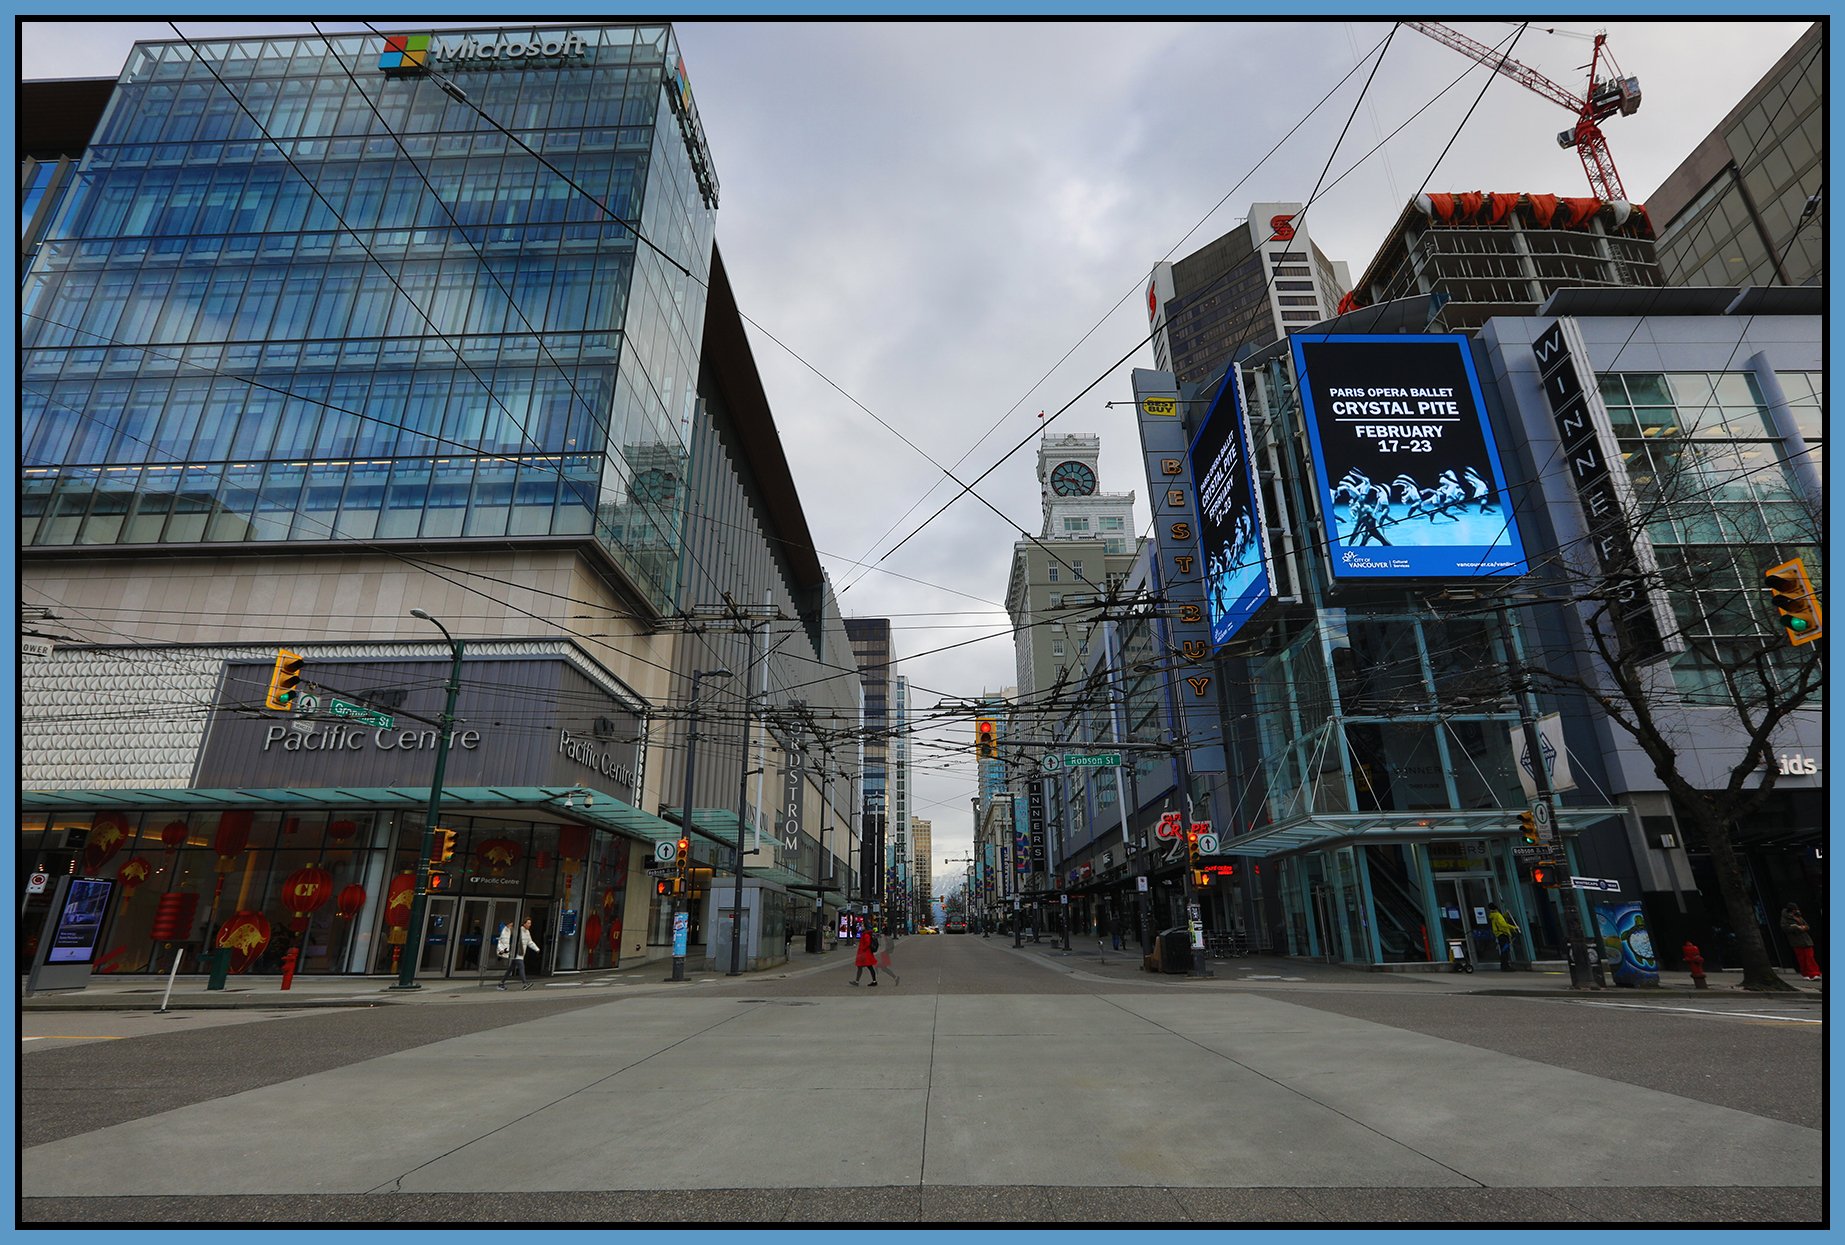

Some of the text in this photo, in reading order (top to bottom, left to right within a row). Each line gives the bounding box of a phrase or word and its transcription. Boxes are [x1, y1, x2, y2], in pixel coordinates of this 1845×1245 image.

[436, 33, 586, 62] Microsoft
[1329, 388, 1453, 398] PARIS OPERA BALLET
[1332, 401, 1459, 415] CRYSTAL PITE
[1355, 425, 1443, 438] FEBRUARY
[1377, 439, 1433, 452] 17-23
[1202, 443, 1237, 508] CRYSTAL PITE
[1161, 459, 1209, 696] BEST BUY
[378, 715, 391, 727] St
[264, 725, 480, 751] Pacific Cenre
[559, 727, 599, 770] Pacific
[601, 753, 635, 788] Centre
[784, 720, 802, 850] ORDSTROM
[1157, 820, 1210, 840] CRPE
[294, 883, 319, 897] CF
